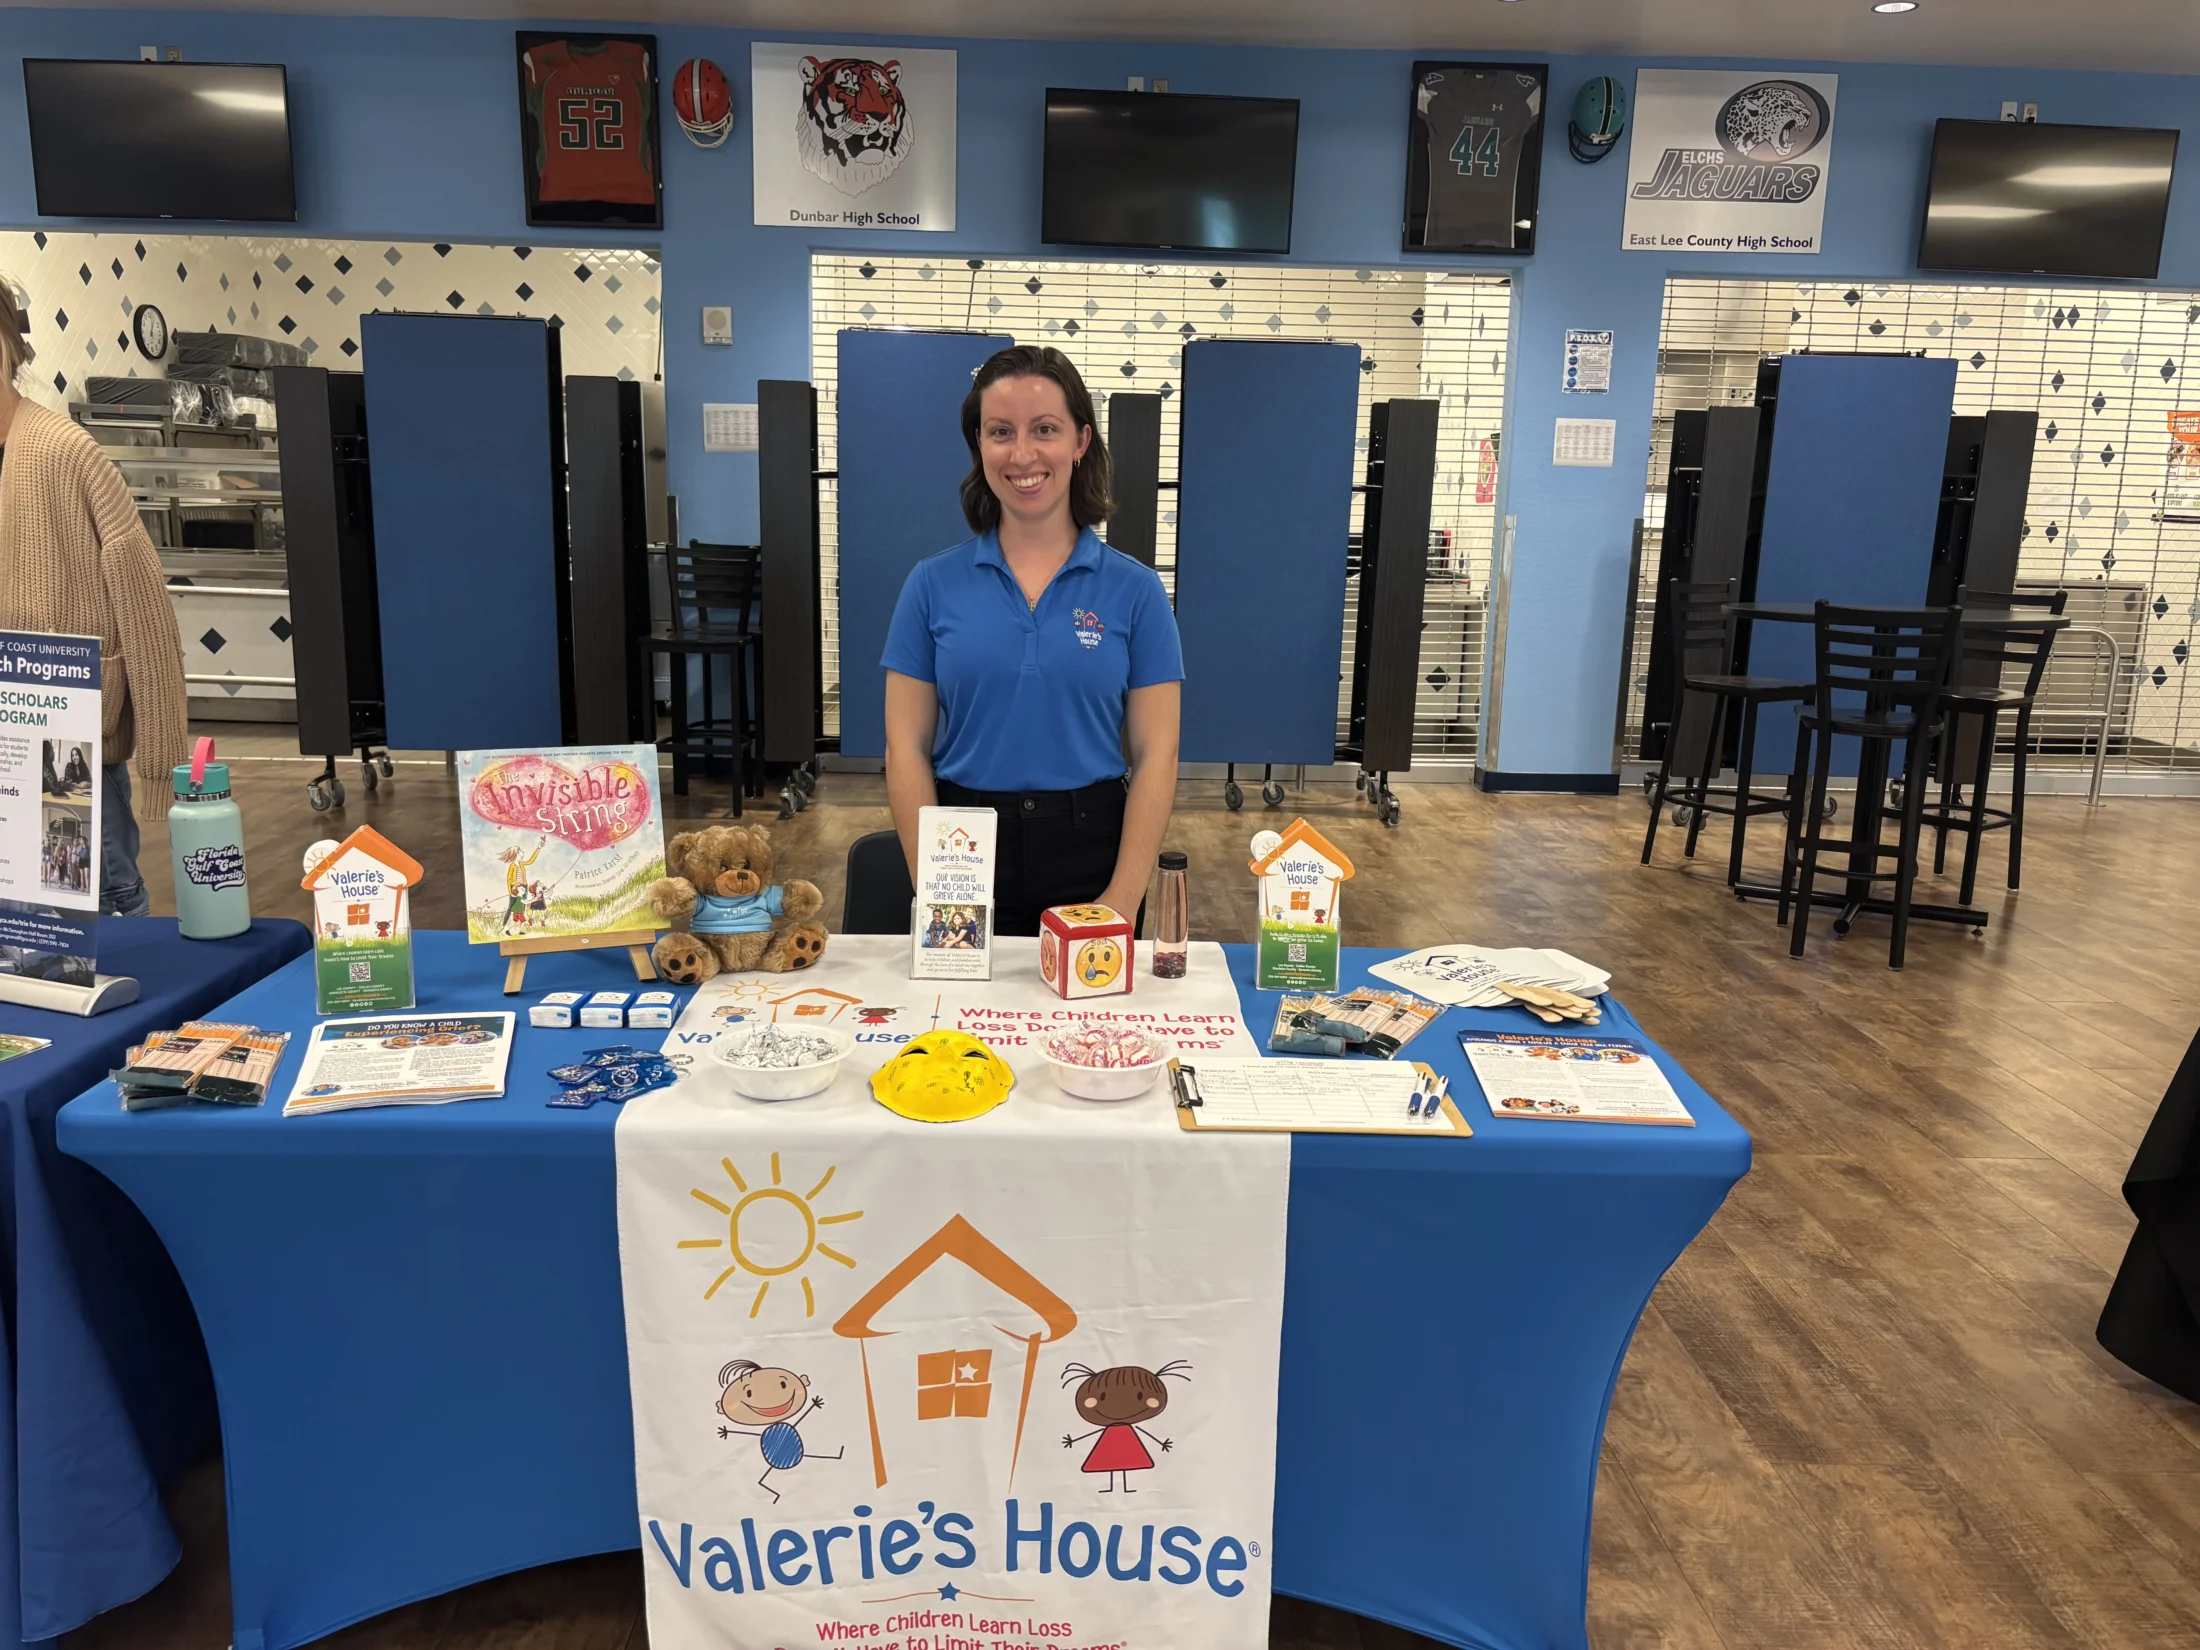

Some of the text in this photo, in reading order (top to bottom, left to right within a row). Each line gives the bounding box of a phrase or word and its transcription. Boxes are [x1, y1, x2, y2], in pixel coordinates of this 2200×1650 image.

[558, 98, 624, 150] 52
[1450, 126, 1500, 177] 44
[1682, 151, 1725, 164] ELCHS
[1633, 149, 1817, 201] JAGUARS
[790, 210, 920, 226] Dunbar High School
[1630, 234, 1813, 250] East Lee County High School
[7, 641, 37, 653] COAST
[39, 644, 91, 658] UNIVERSITY
[16, 656, 91, 681] Programs
[0, 690, 68, 710] SCHOLARS
[0, 708, 48, 727] OGRAM
[494, 770, 520, 784] The
[0, 784, 20, 797] inds
[485, 766, 631, 815] Invisible
[536, 802, 630, 836] String
[198, 844, 238, 862] Florida
[930, 854, 984, 864] Valerie's House
[184, 856, 243, 872] Gulf Coast
[574, 853, 623, 880] Patrice Karst
[1280, 860, 1324, 874] Valerie's
[191, 870, 243, 882] University
[331, 870, 384, 886] Valerie's
[936, 873, 976, 882] OUR VISION IS
[1286, 874, 1318, 886] House
[341, 884, 379, 898] House
[926, 882, 986, 892] THAT NO CHILD WILL
[934, 891, 954, 900] GRIEVE
[960, 1008, 1236, 1024] Where Children Learn
[345, 1024, 481, 1038] Experiencing Grief?
[402, 1022, 427, 1030] KNOW
[957, 1020, 1016, 1032] Loss
[1205, 1026, 1235, 1037] to
[855, 1032, 914, 1044] use
[970, 1033, 1028, 1046] imit
[1496, 1034, 1598, 1044] Valerie's House
[648, 1500, 977, 1595] Valerie's
[816, 1610, 1072, 1642] Where Children Learn Loss
